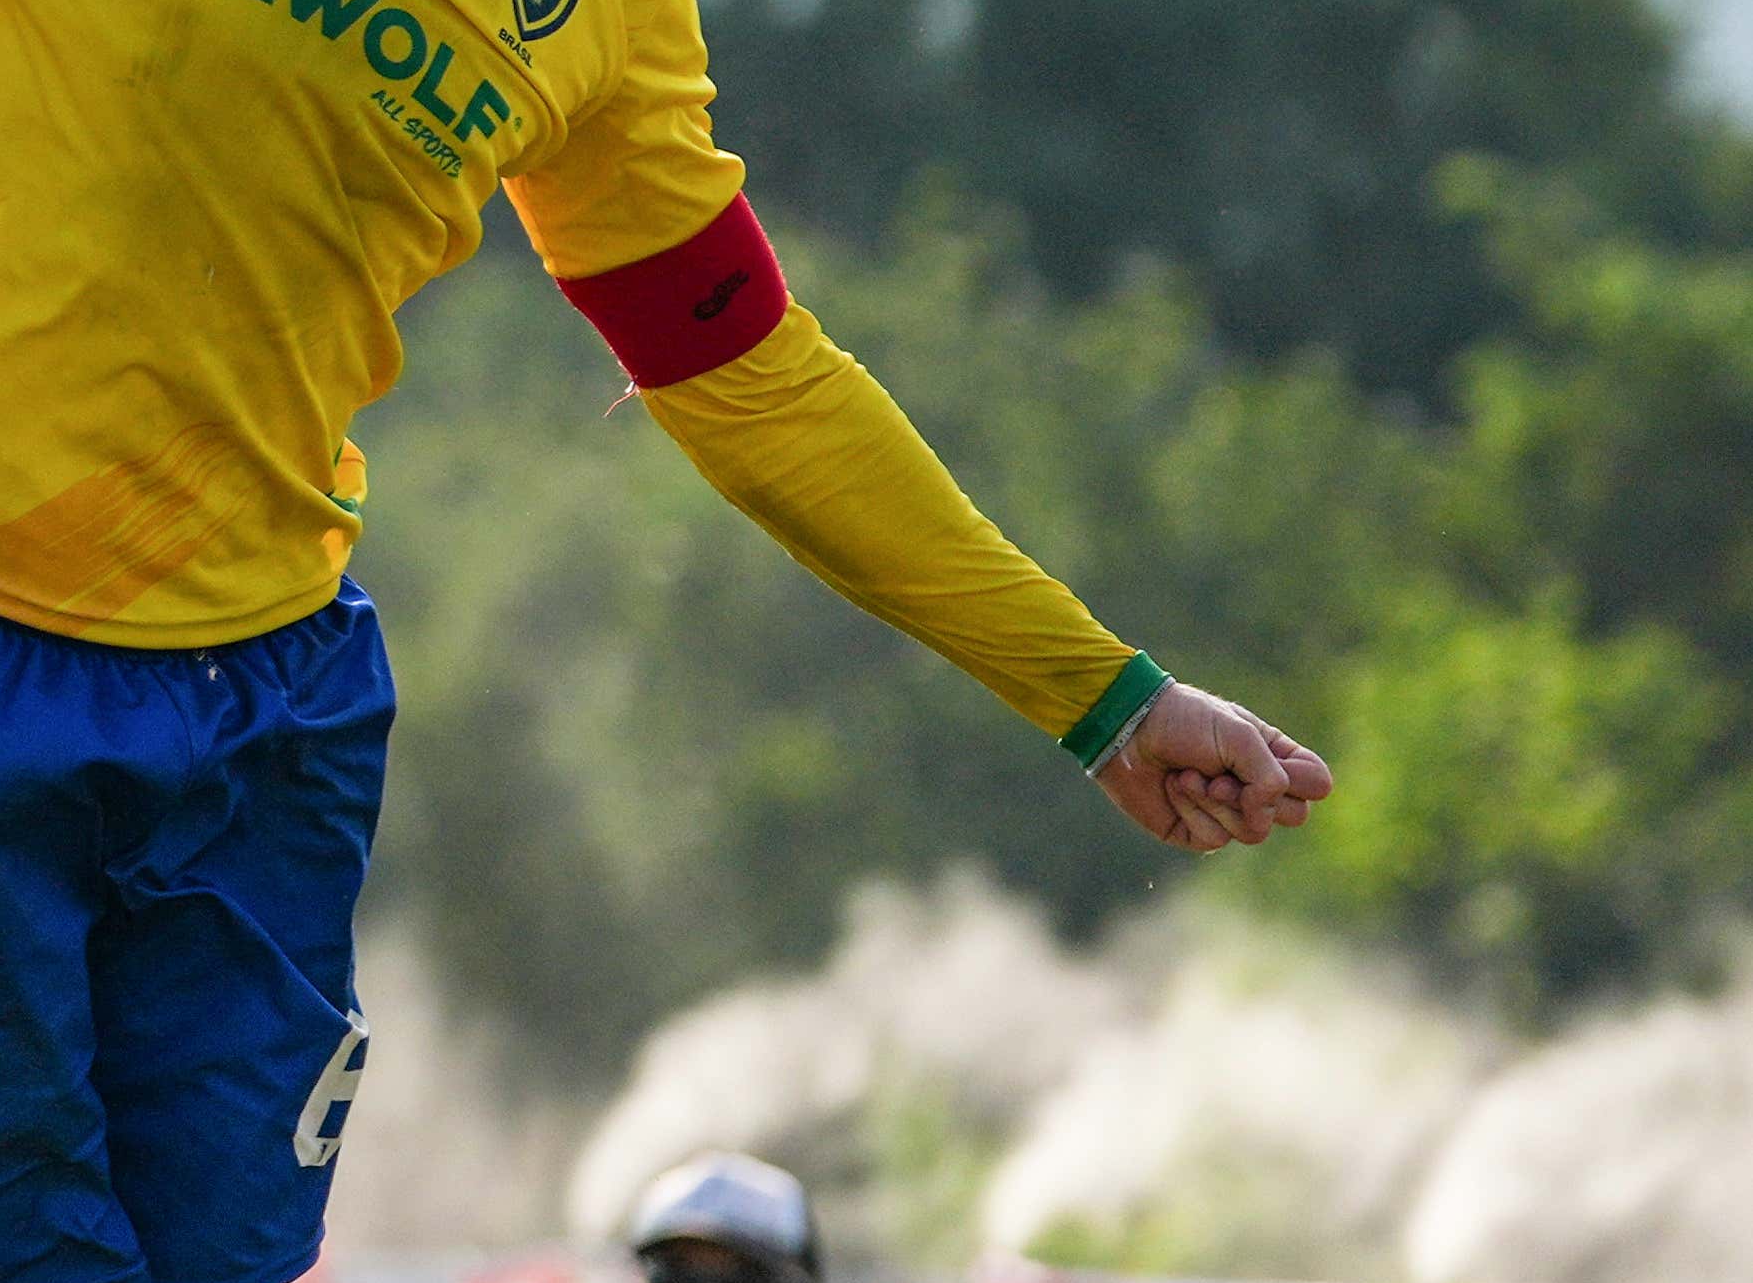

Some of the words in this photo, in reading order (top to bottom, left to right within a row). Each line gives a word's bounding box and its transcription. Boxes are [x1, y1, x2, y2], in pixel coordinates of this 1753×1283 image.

[498, 27, 533, 68] BRASIL
[370, 90, 406, 122] ALL
[402, 117, 464, 179] SPORTS
